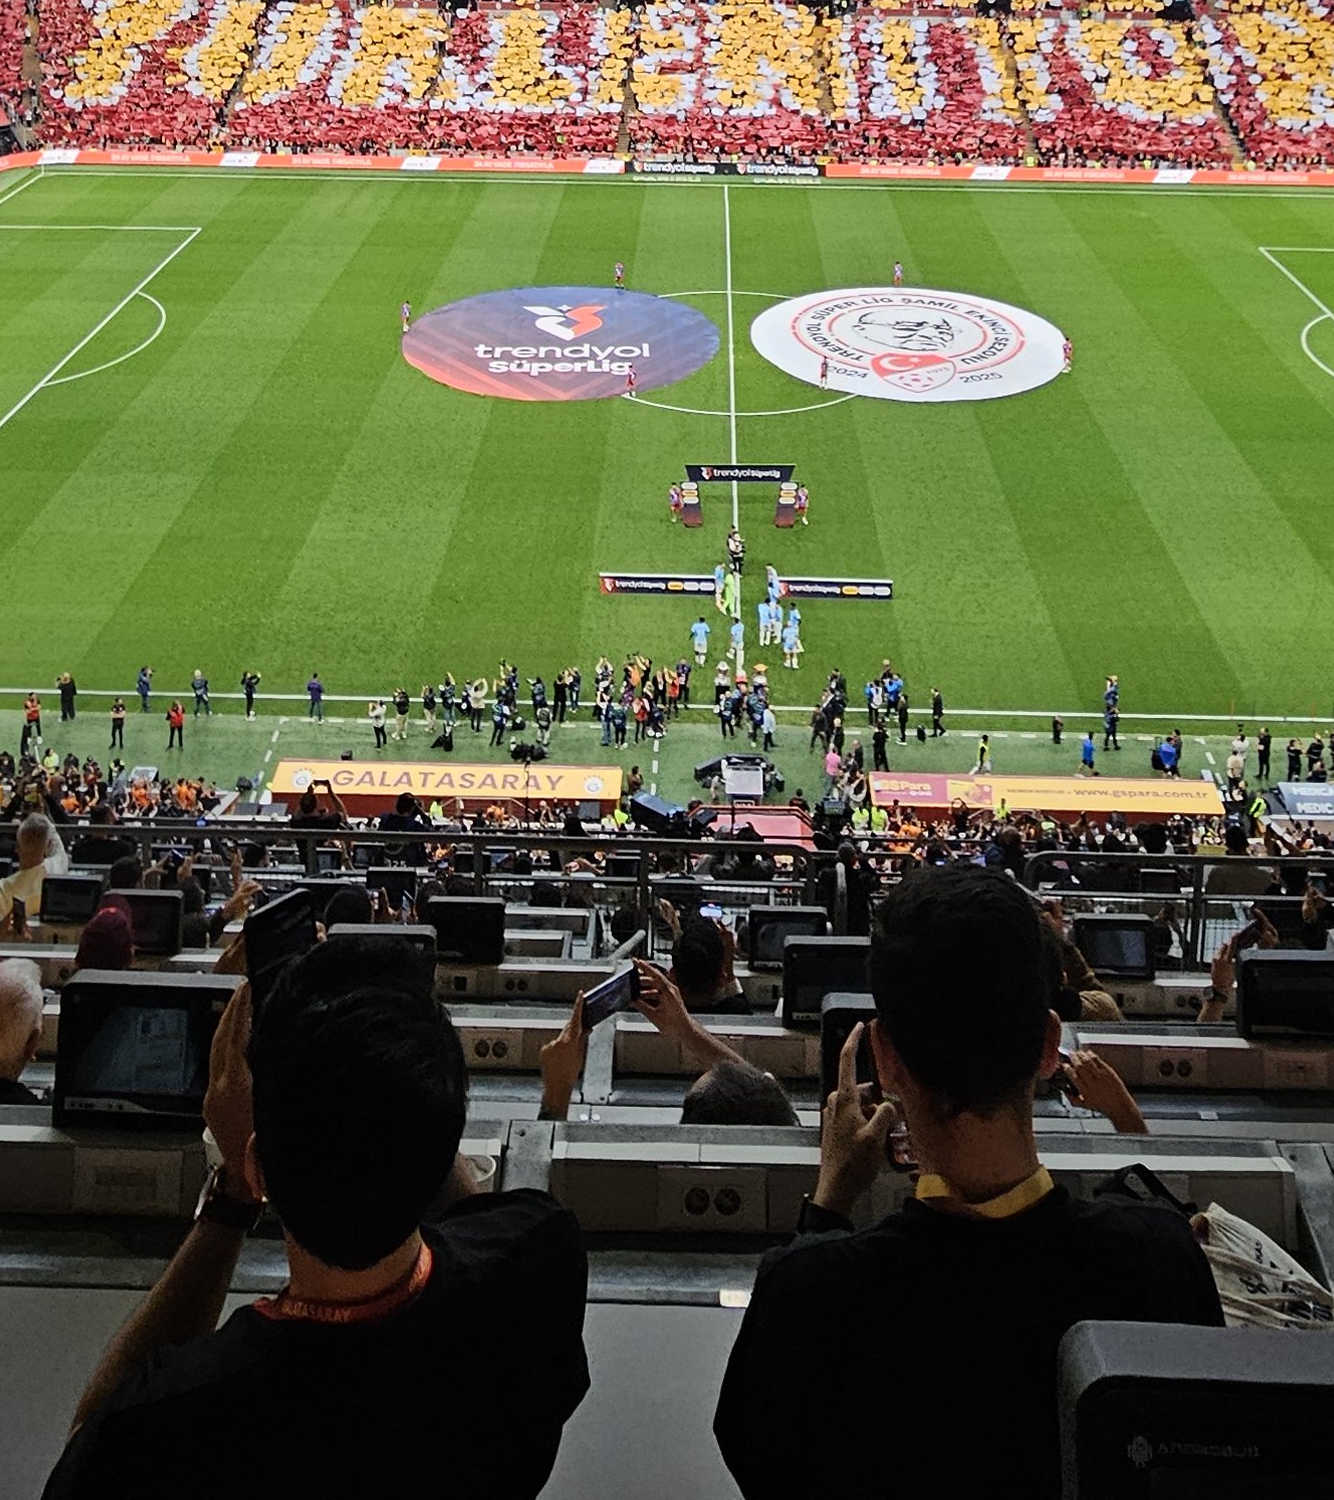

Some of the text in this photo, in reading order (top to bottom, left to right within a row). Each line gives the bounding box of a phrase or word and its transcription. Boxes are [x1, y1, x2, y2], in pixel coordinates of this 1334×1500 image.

[901, 297, 959, 310] ŞAMİL
[474, 343, 650, 360] trendyol
[828, 366, 868, 378] 2024
[959, 372, 1003, 383] 2025
[332, 769, 565, 792] GALATASARAY
[1074, 788, 1207, 799] www.gspara.com.tr
